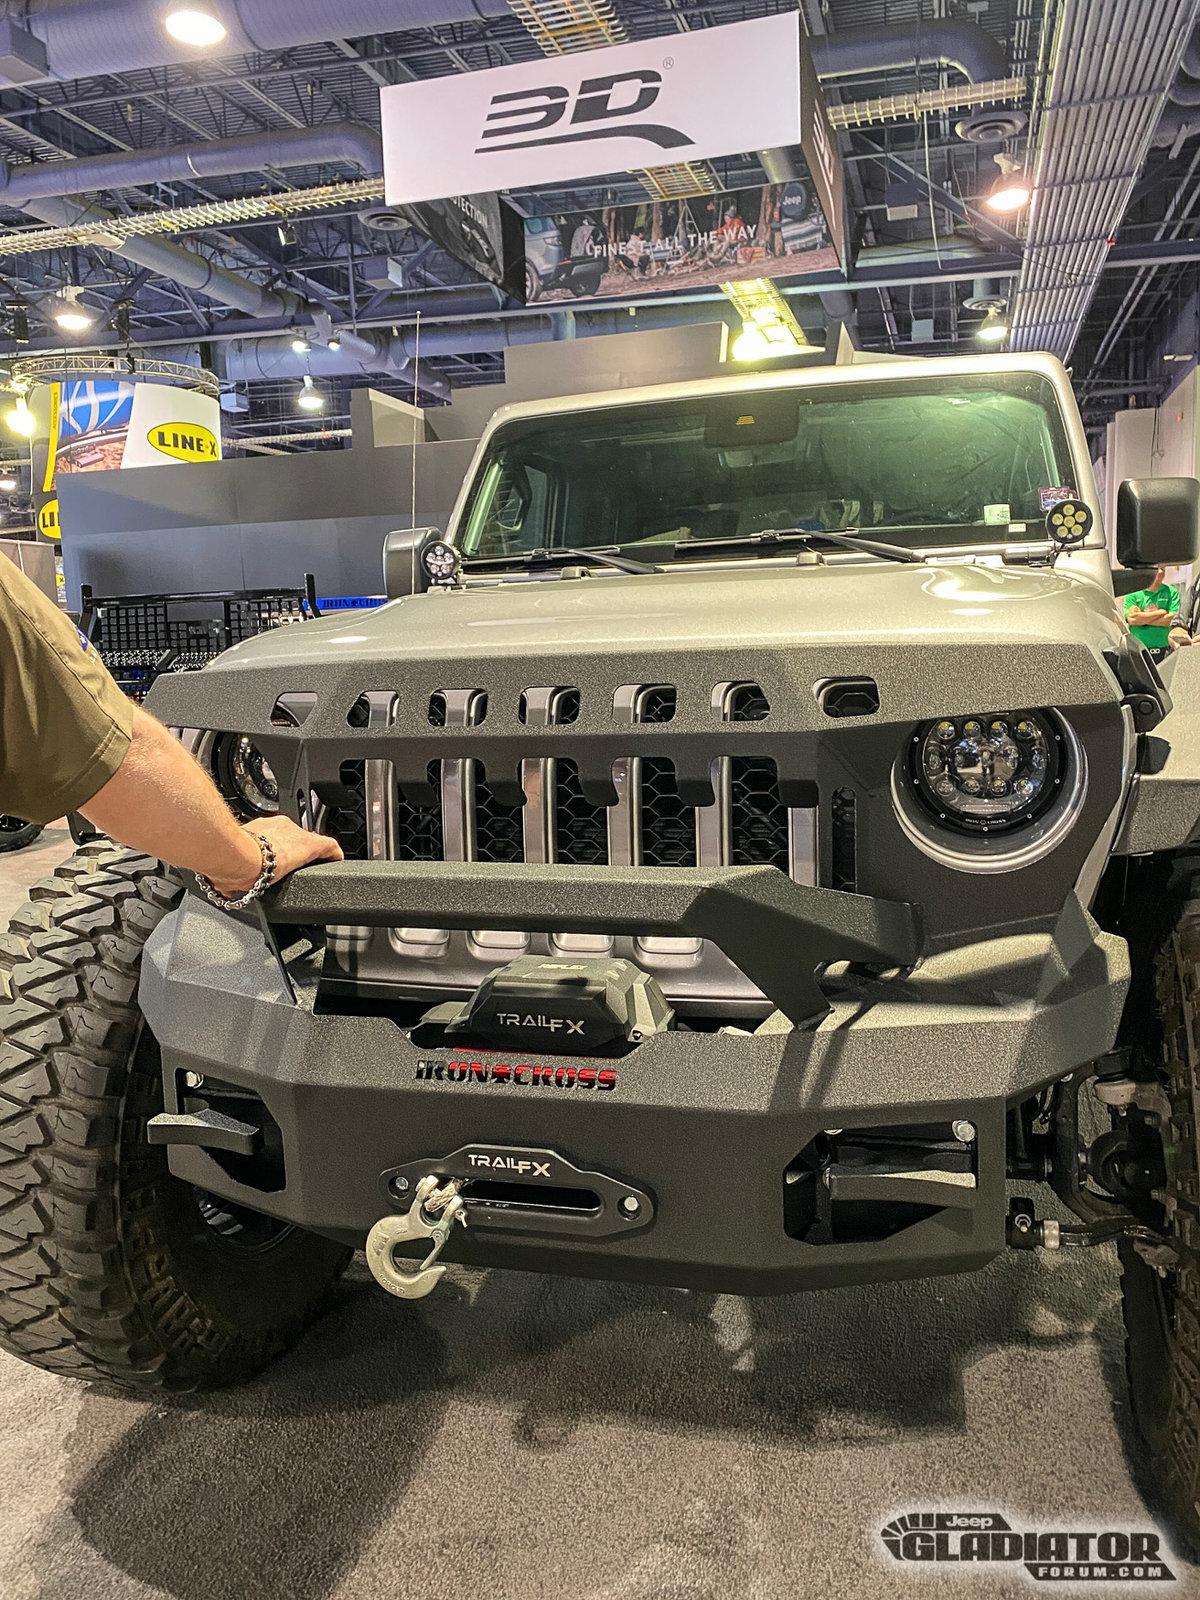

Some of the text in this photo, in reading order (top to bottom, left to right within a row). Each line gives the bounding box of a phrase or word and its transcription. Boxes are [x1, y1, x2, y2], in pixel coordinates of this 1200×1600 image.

[782, 195, 802, 206] Jeep
[655, 236, 684, 251] ALL
[687, 230, 717, 247] THE
[723, 224, 757, 241] WAY
[496, 1013, 585, 1035] TRAILFX
[415, 1060, 618, 1091] IRON CROSS
[468, 1154, 551, 1178] TRAILFX
